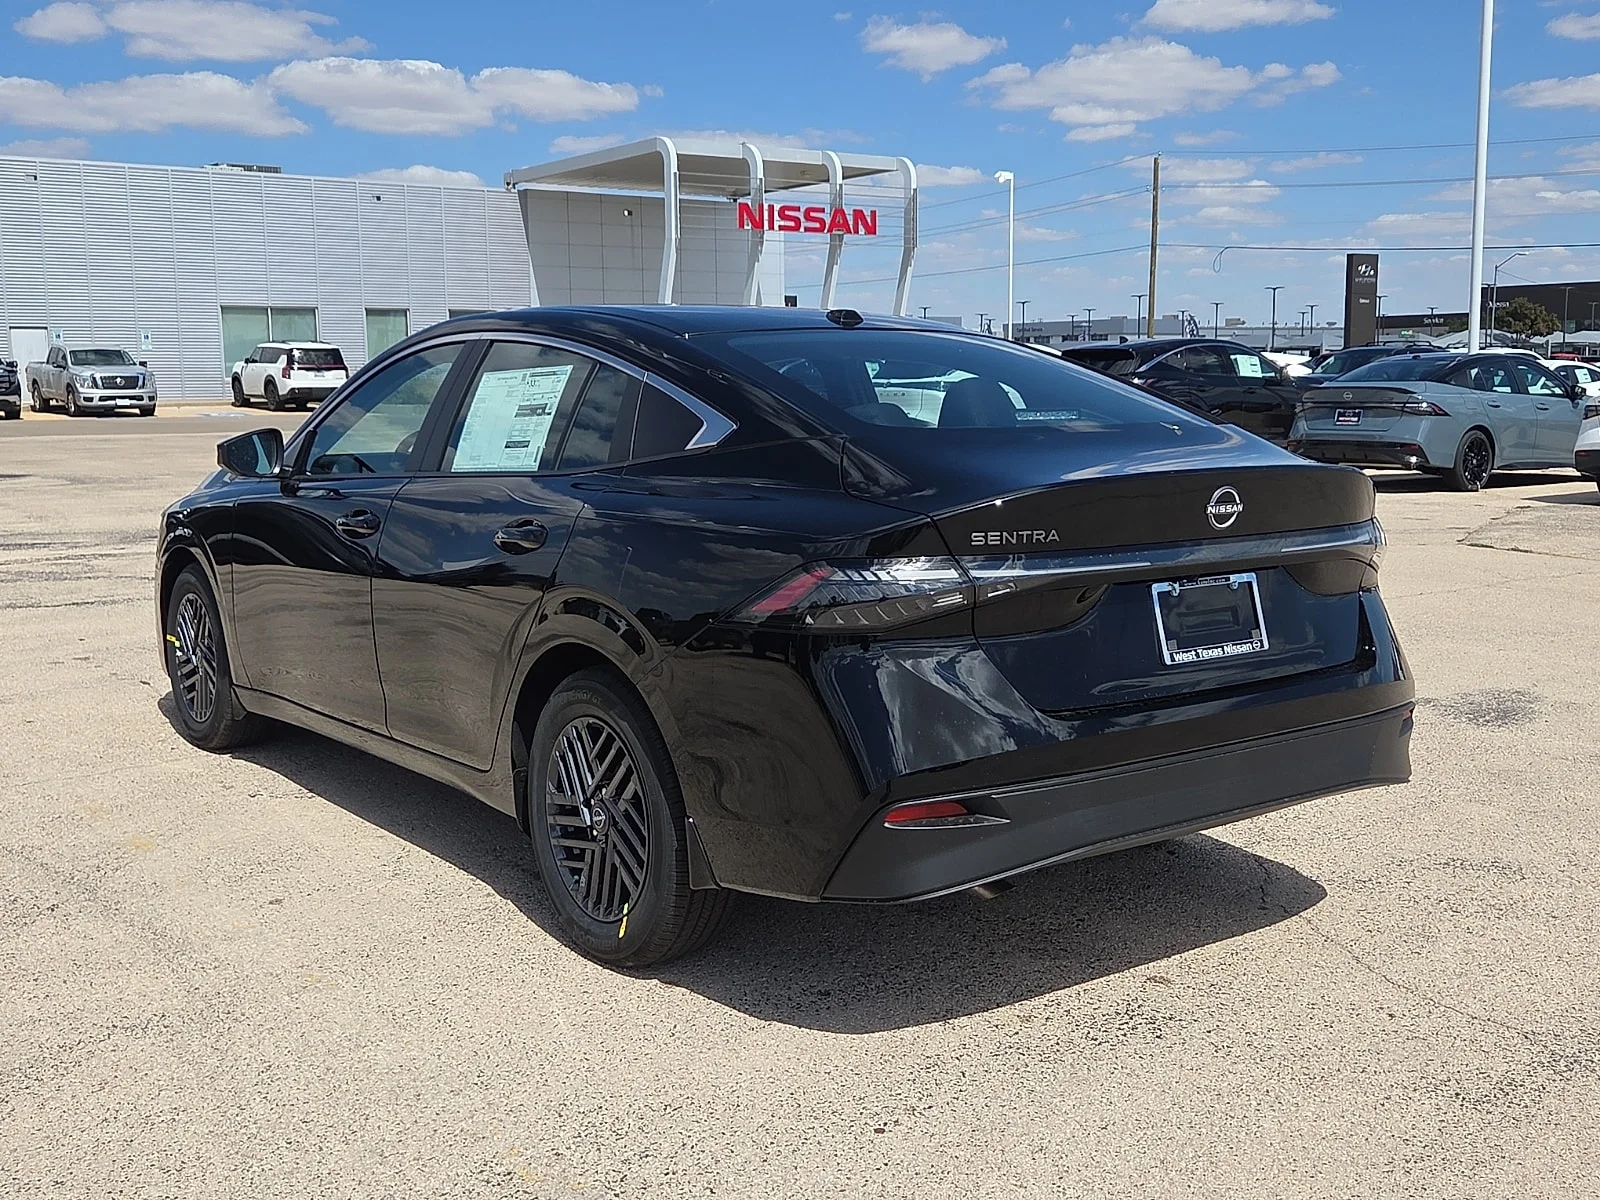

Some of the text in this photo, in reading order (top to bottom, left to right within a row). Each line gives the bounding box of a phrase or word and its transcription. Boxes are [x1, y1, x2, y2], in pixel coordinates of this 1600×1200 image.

[737, 202, 877, 236] NISSAN
[1206, 503, 1244, 514] NISSAN
[970, 529, 1060, 546] SENTRA
[1173, 642, 1253, 662] West Texas Nissan
